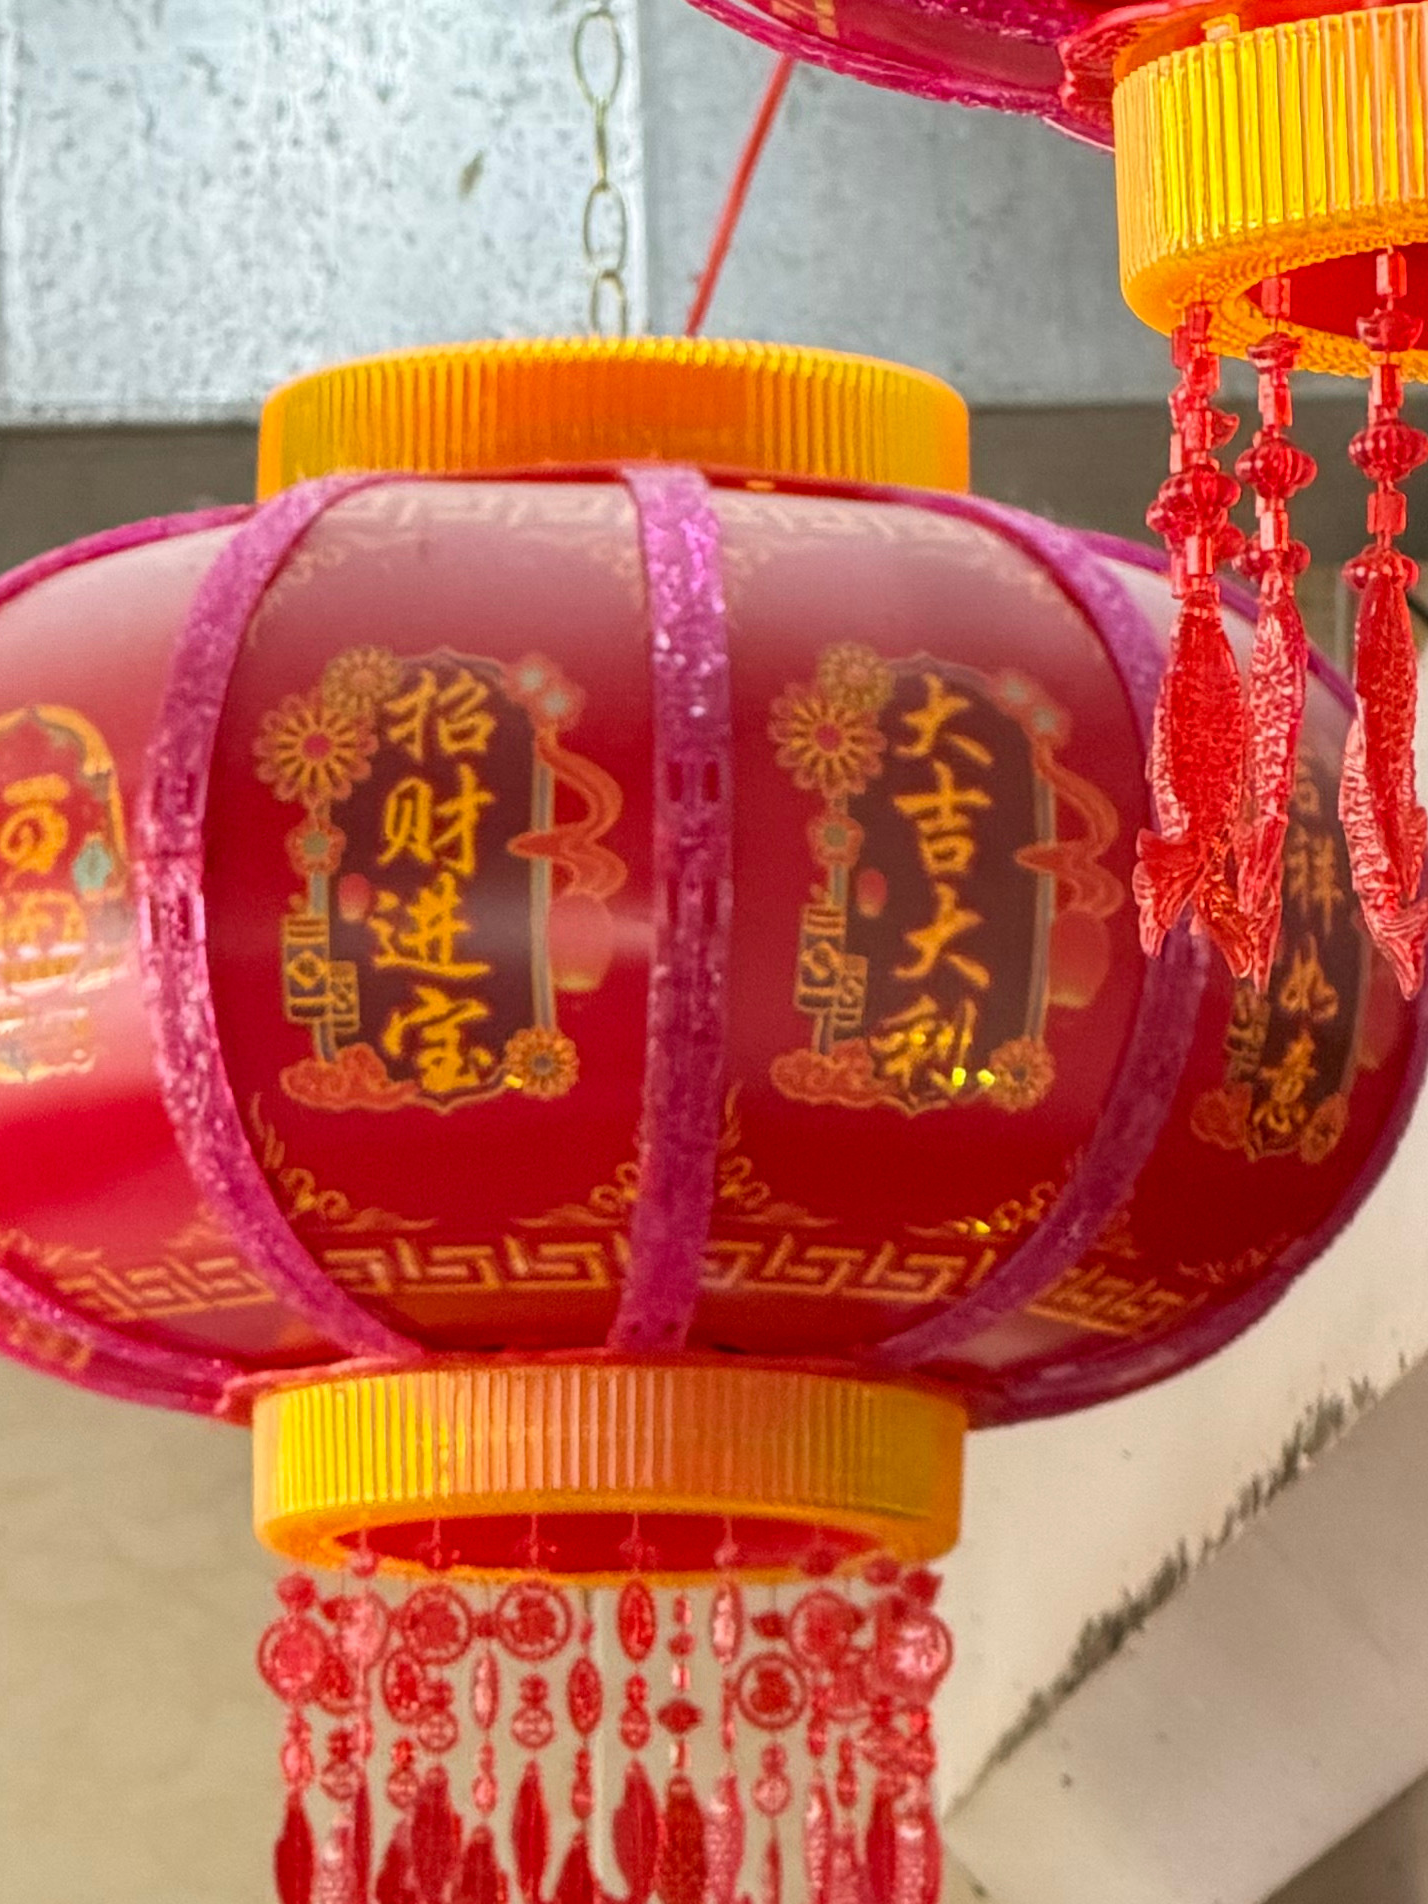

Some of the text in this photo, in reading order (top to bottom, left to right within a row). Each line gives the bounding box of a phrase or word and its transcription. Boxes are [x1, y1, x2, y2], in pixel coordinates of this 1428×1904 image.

[370, 666, 498, 1100] 招财进宝
[880, 674, 996, 1100] 大吉大利
